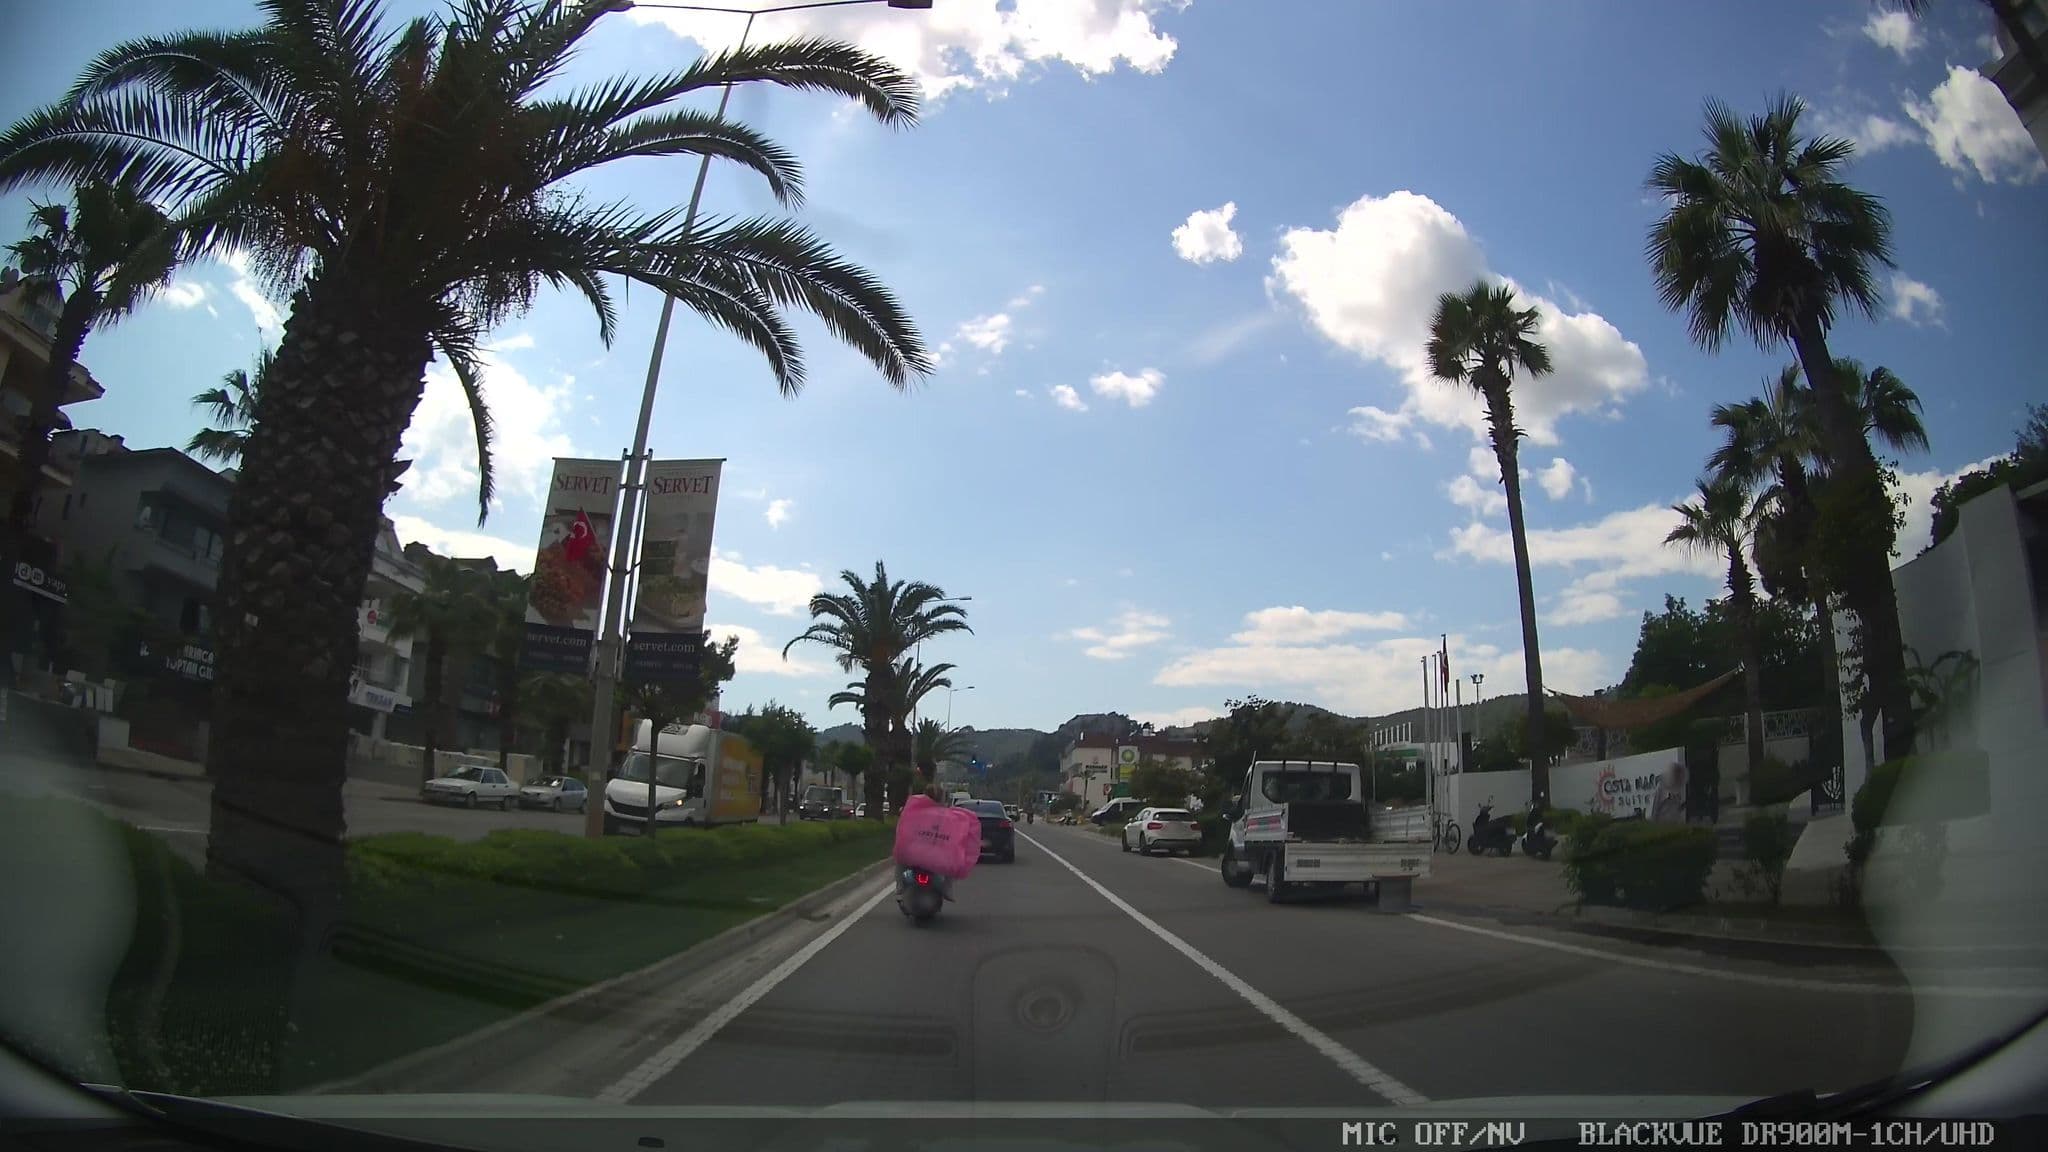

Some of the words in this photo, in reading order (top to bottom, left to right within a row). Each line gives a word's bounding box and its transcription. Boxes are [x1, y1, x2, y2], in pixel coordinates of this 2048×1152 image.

[555, 474, 612, 495] SERVET
[651, 475, 714, 496] SERVET
[527, 632, 588, 648] servet.com
[633, 641, 695, 654] servet.com
